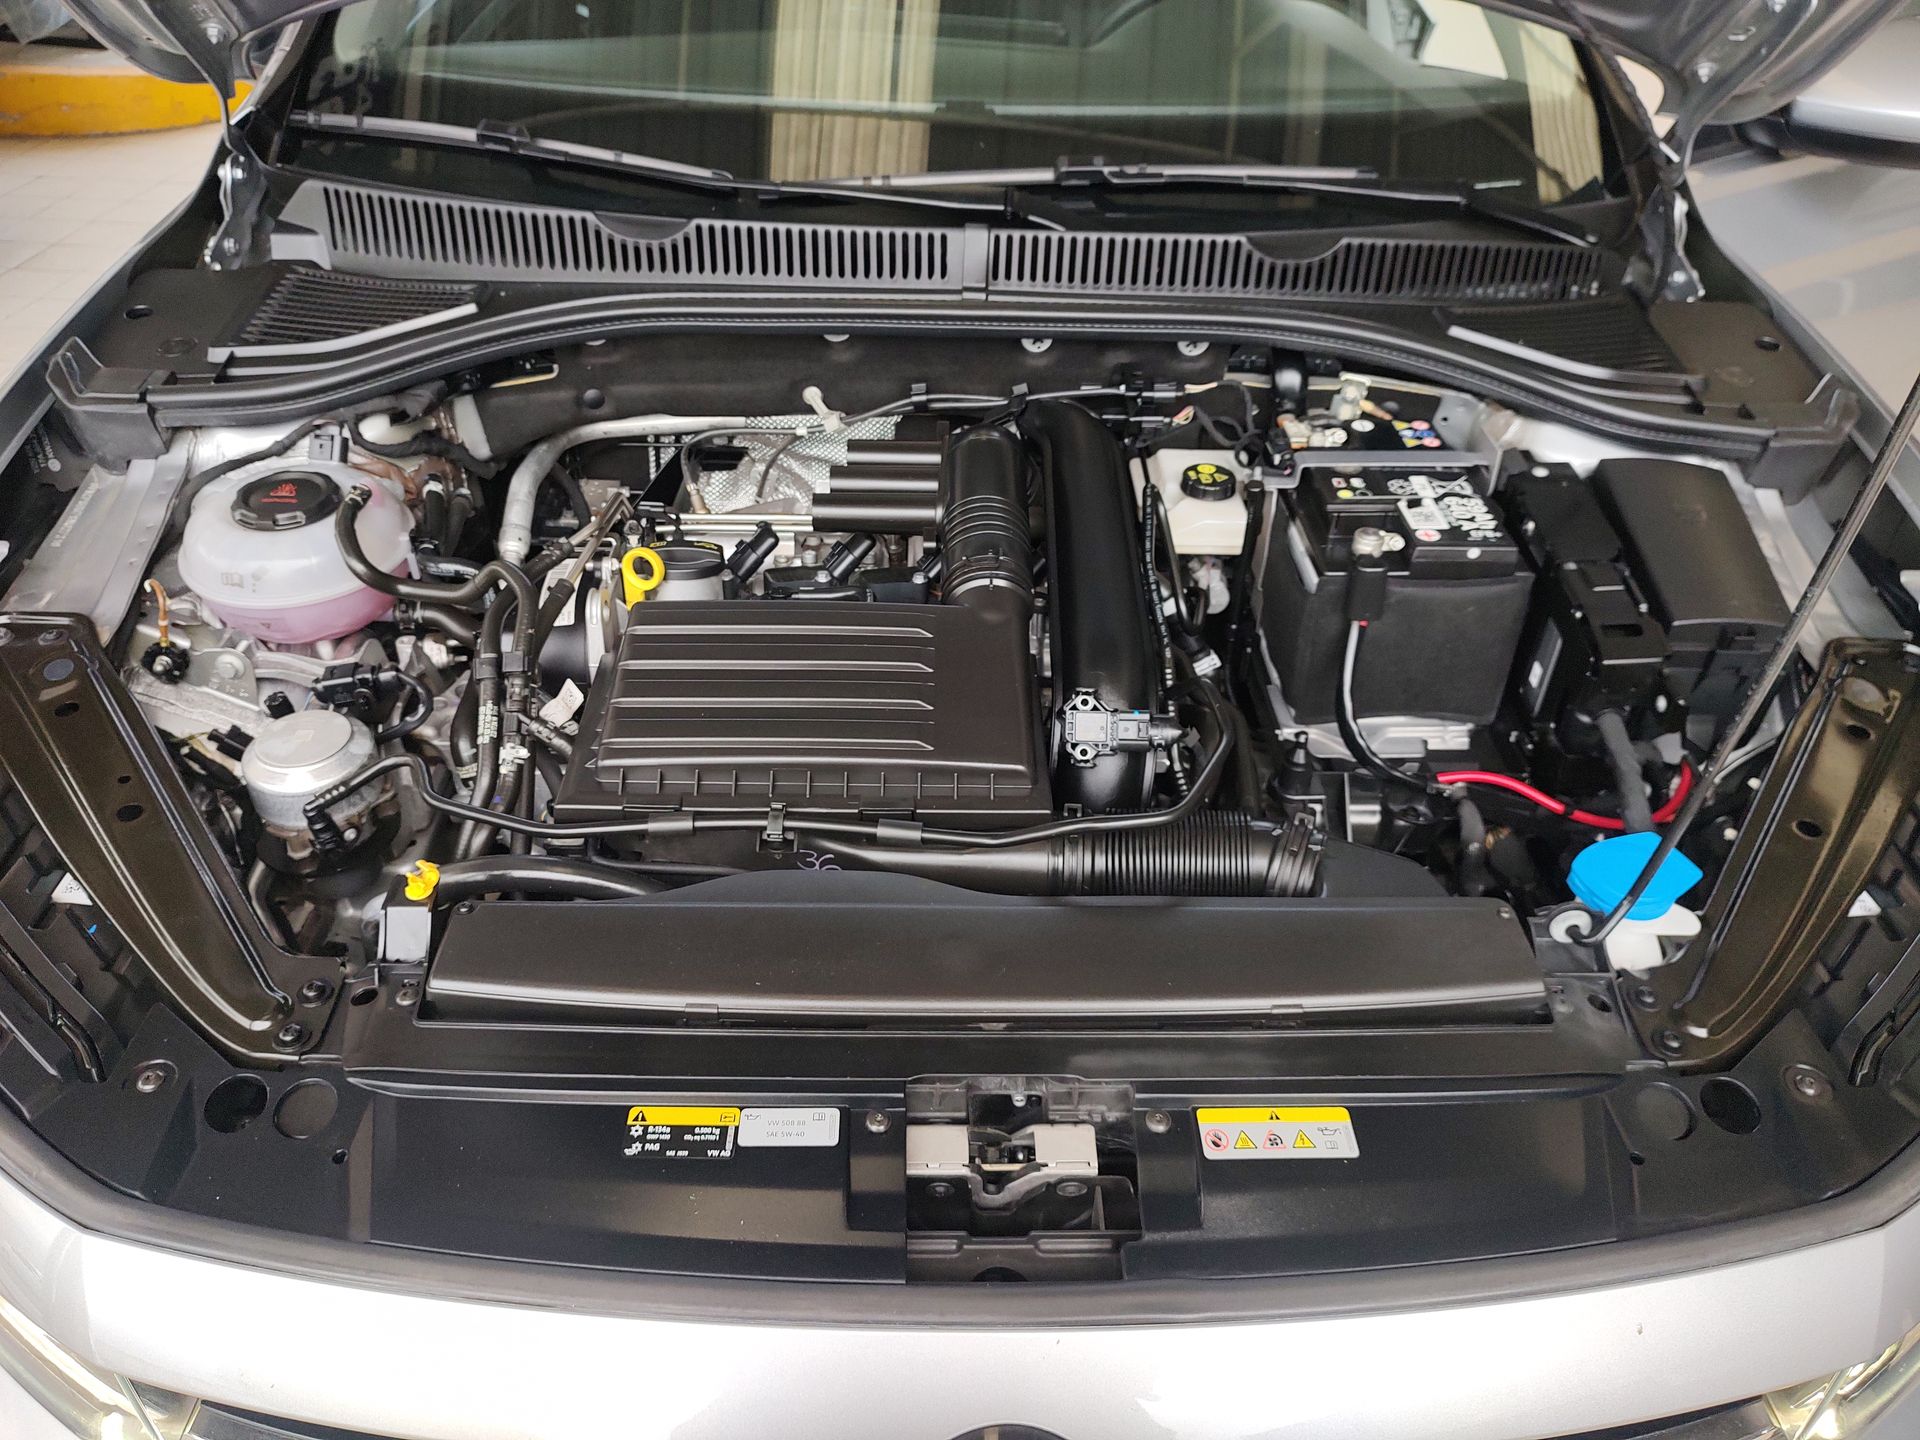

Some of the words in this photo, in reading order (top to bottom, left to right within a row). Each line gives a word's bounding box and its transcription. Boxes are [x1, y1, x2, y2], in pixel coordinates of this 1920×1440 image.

[648, 1125, 671, 1134] R-134a
[712, 1126, 720, 1135] kg
[644, 1143, 660, 1151] PAG
[707, 1149, 720, 1157] VW
[720, 1149, 731, 1157] AG
